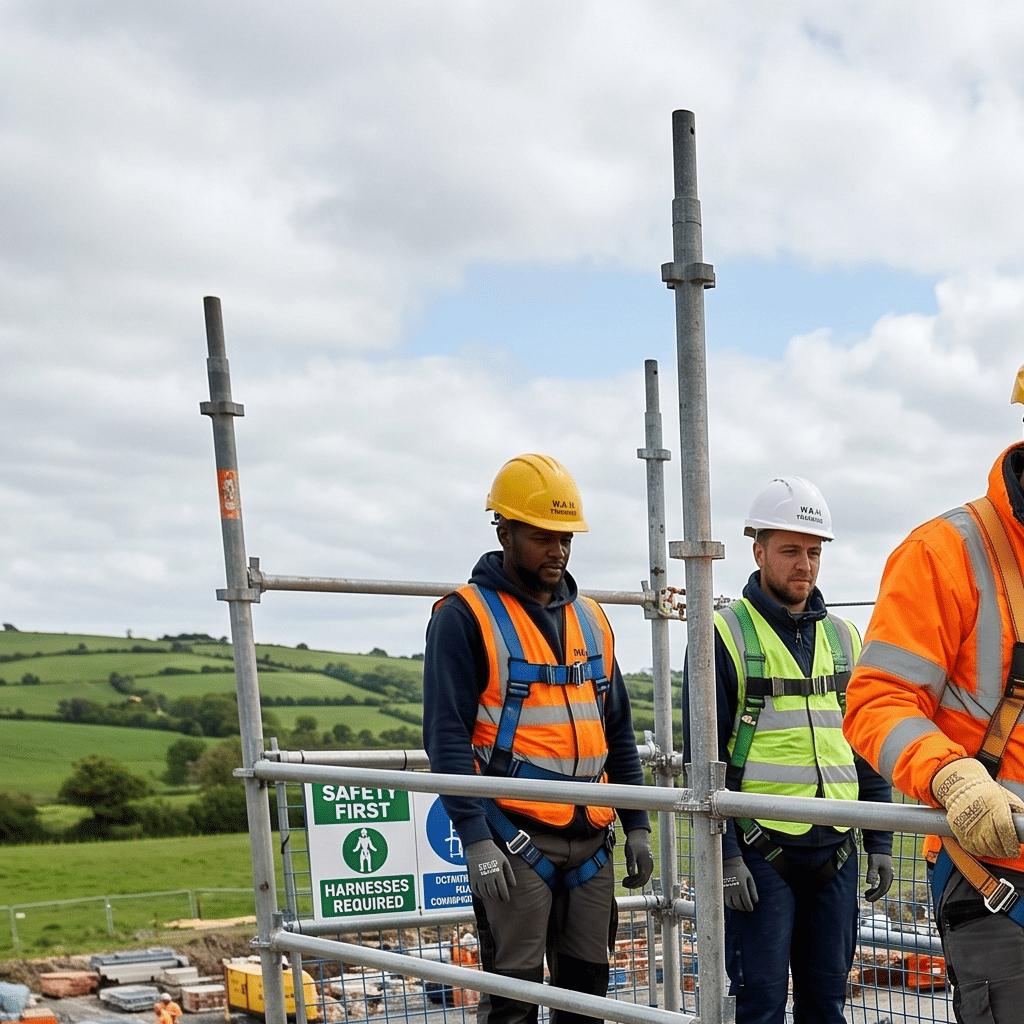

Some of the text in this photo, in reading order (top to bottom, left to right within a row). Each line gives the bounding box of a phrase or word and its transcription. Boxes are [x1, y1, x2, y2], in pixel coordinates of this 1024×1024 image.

[335, 802, 390, 820] FIRST
[324, 879, 409, 898] HARNESSES
[333, 895, 404, 913] REQUIRED
